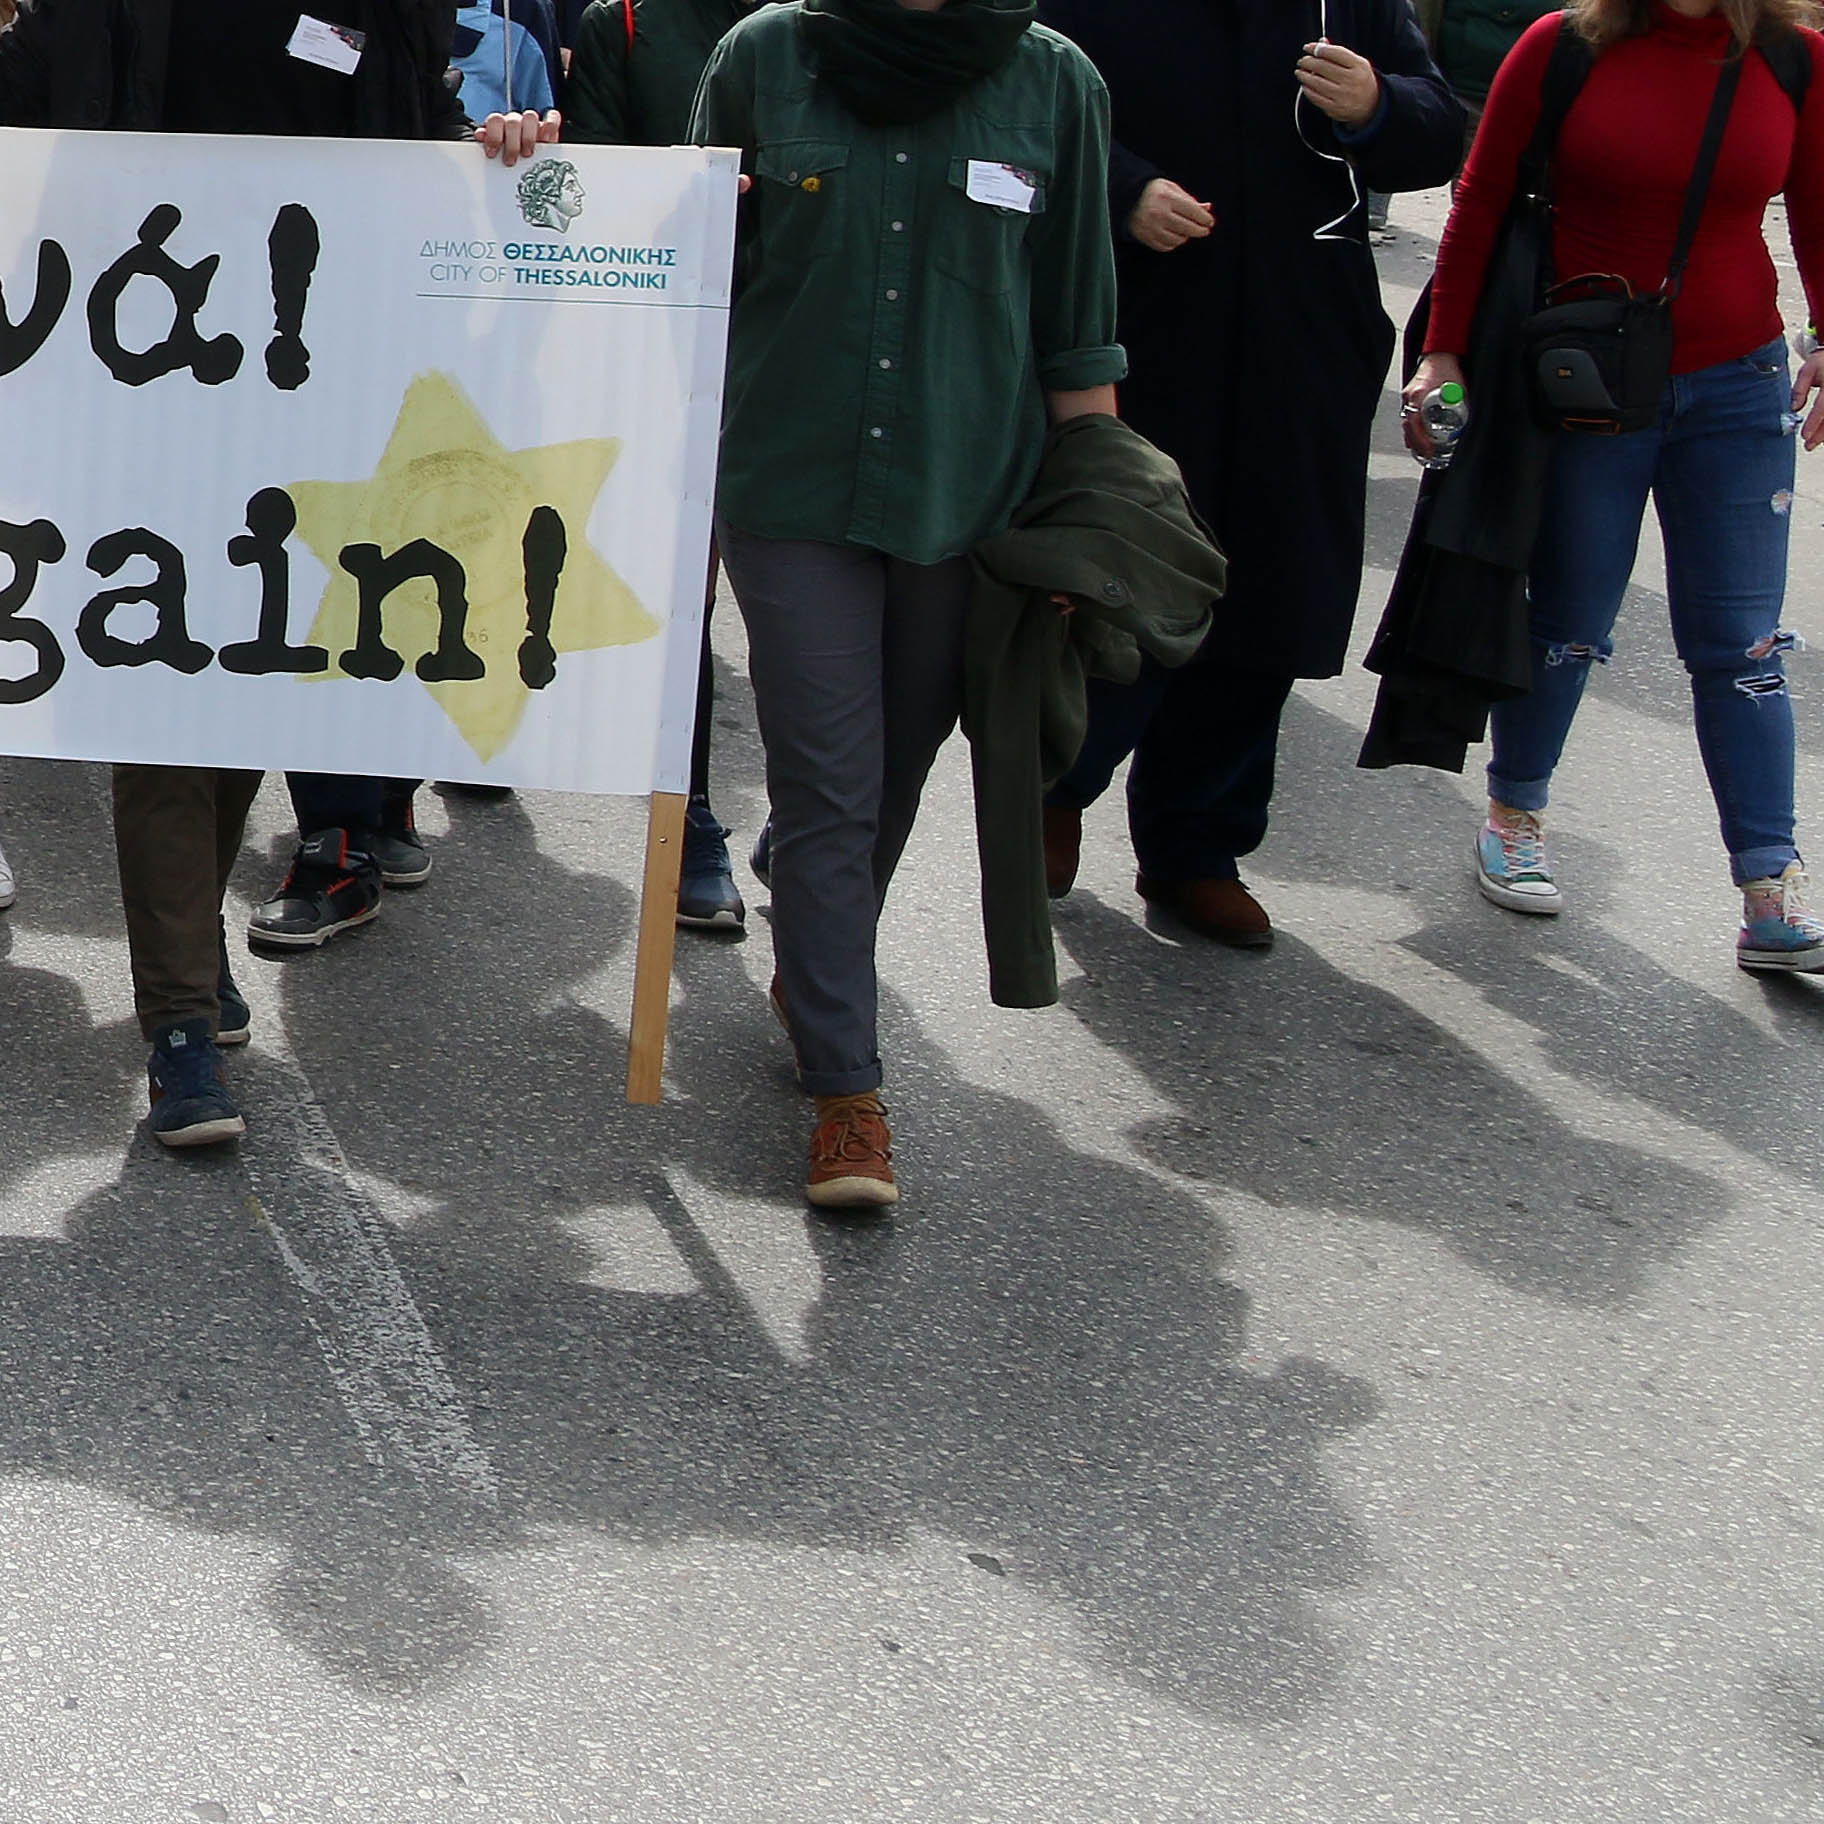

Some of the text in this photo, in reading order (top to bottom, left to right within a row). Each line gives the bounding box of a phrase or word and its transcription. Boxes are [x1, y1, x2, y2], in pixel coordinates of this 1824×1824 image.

[419, 239, 677, 267] ΔΗΜΟΣ ΘΕΣΣΑΛΟΝΙΚΗΣ
[430, 263, 667, 290] CITY OF THESSALONIKI
